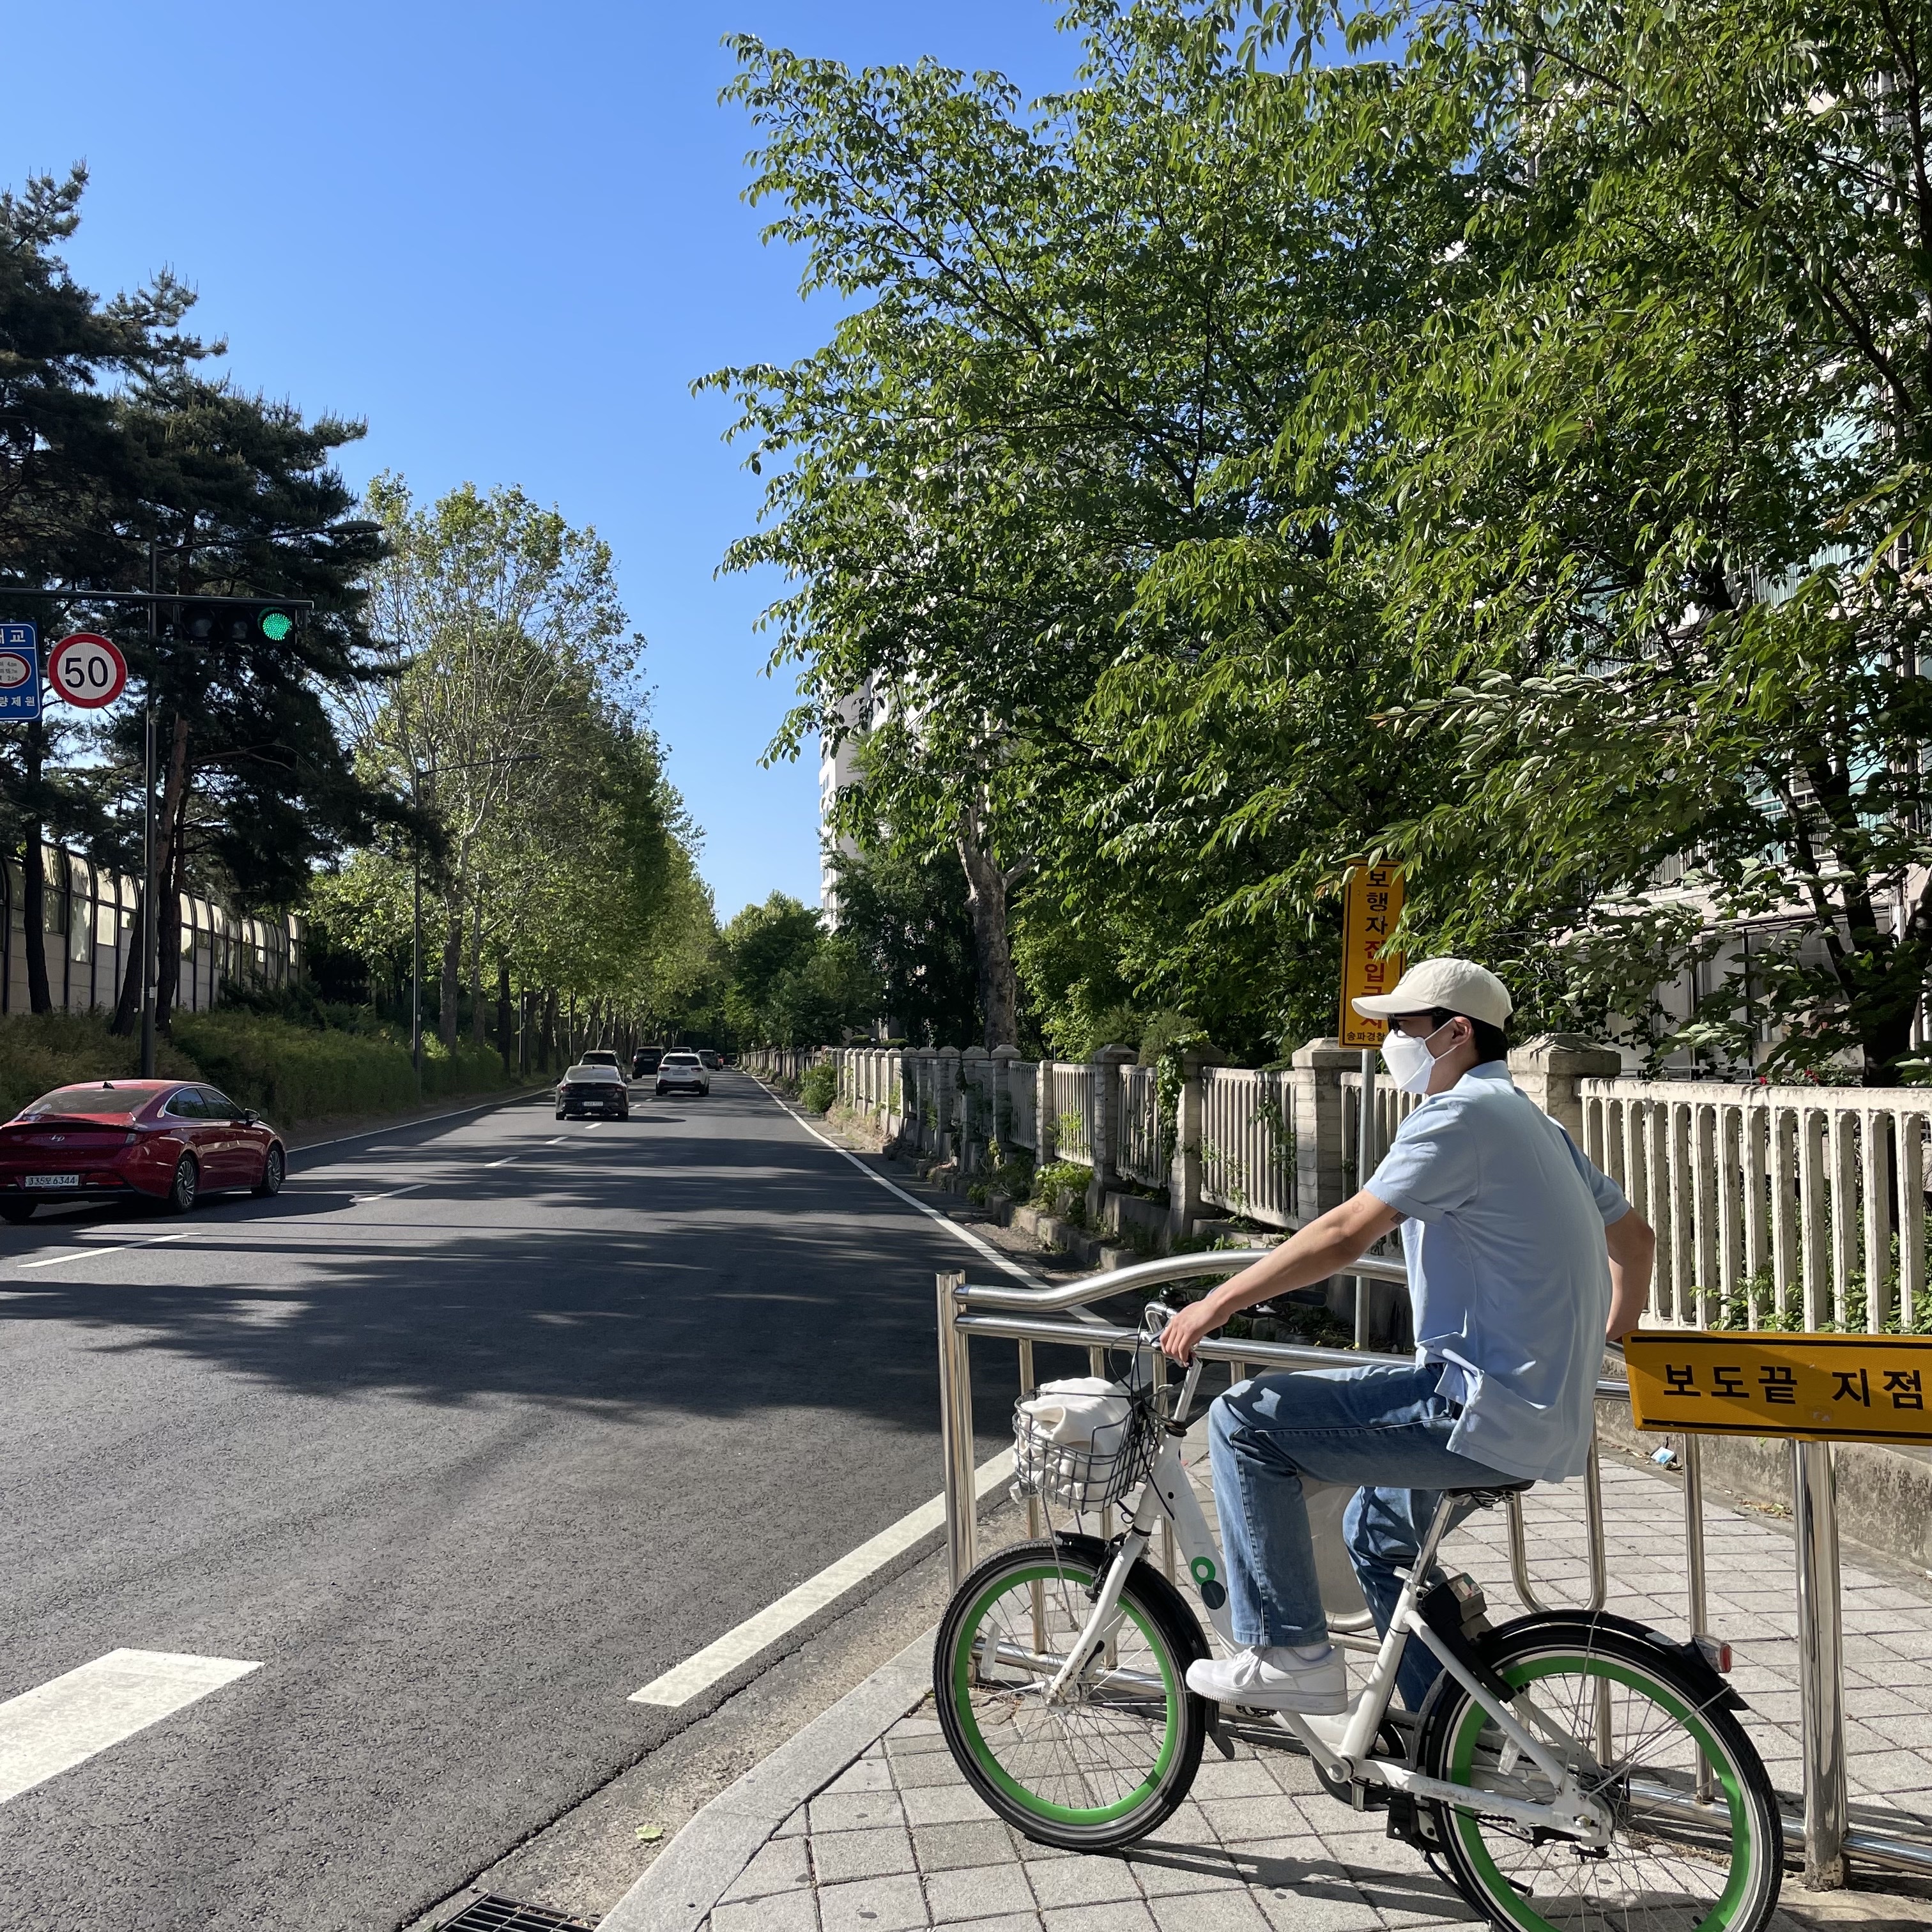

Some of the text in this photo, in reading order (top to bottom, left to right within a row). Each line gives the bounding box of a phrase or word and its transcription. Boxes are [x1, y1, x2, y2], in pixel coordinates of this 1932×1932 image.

[0, 628, 26, 644] 교
[65, 656, 108, 688] 50
[1347, 1031, 1385, 1042] 송파경찰
[1664, 1363, 1924, 1411] 보도끝 지점
